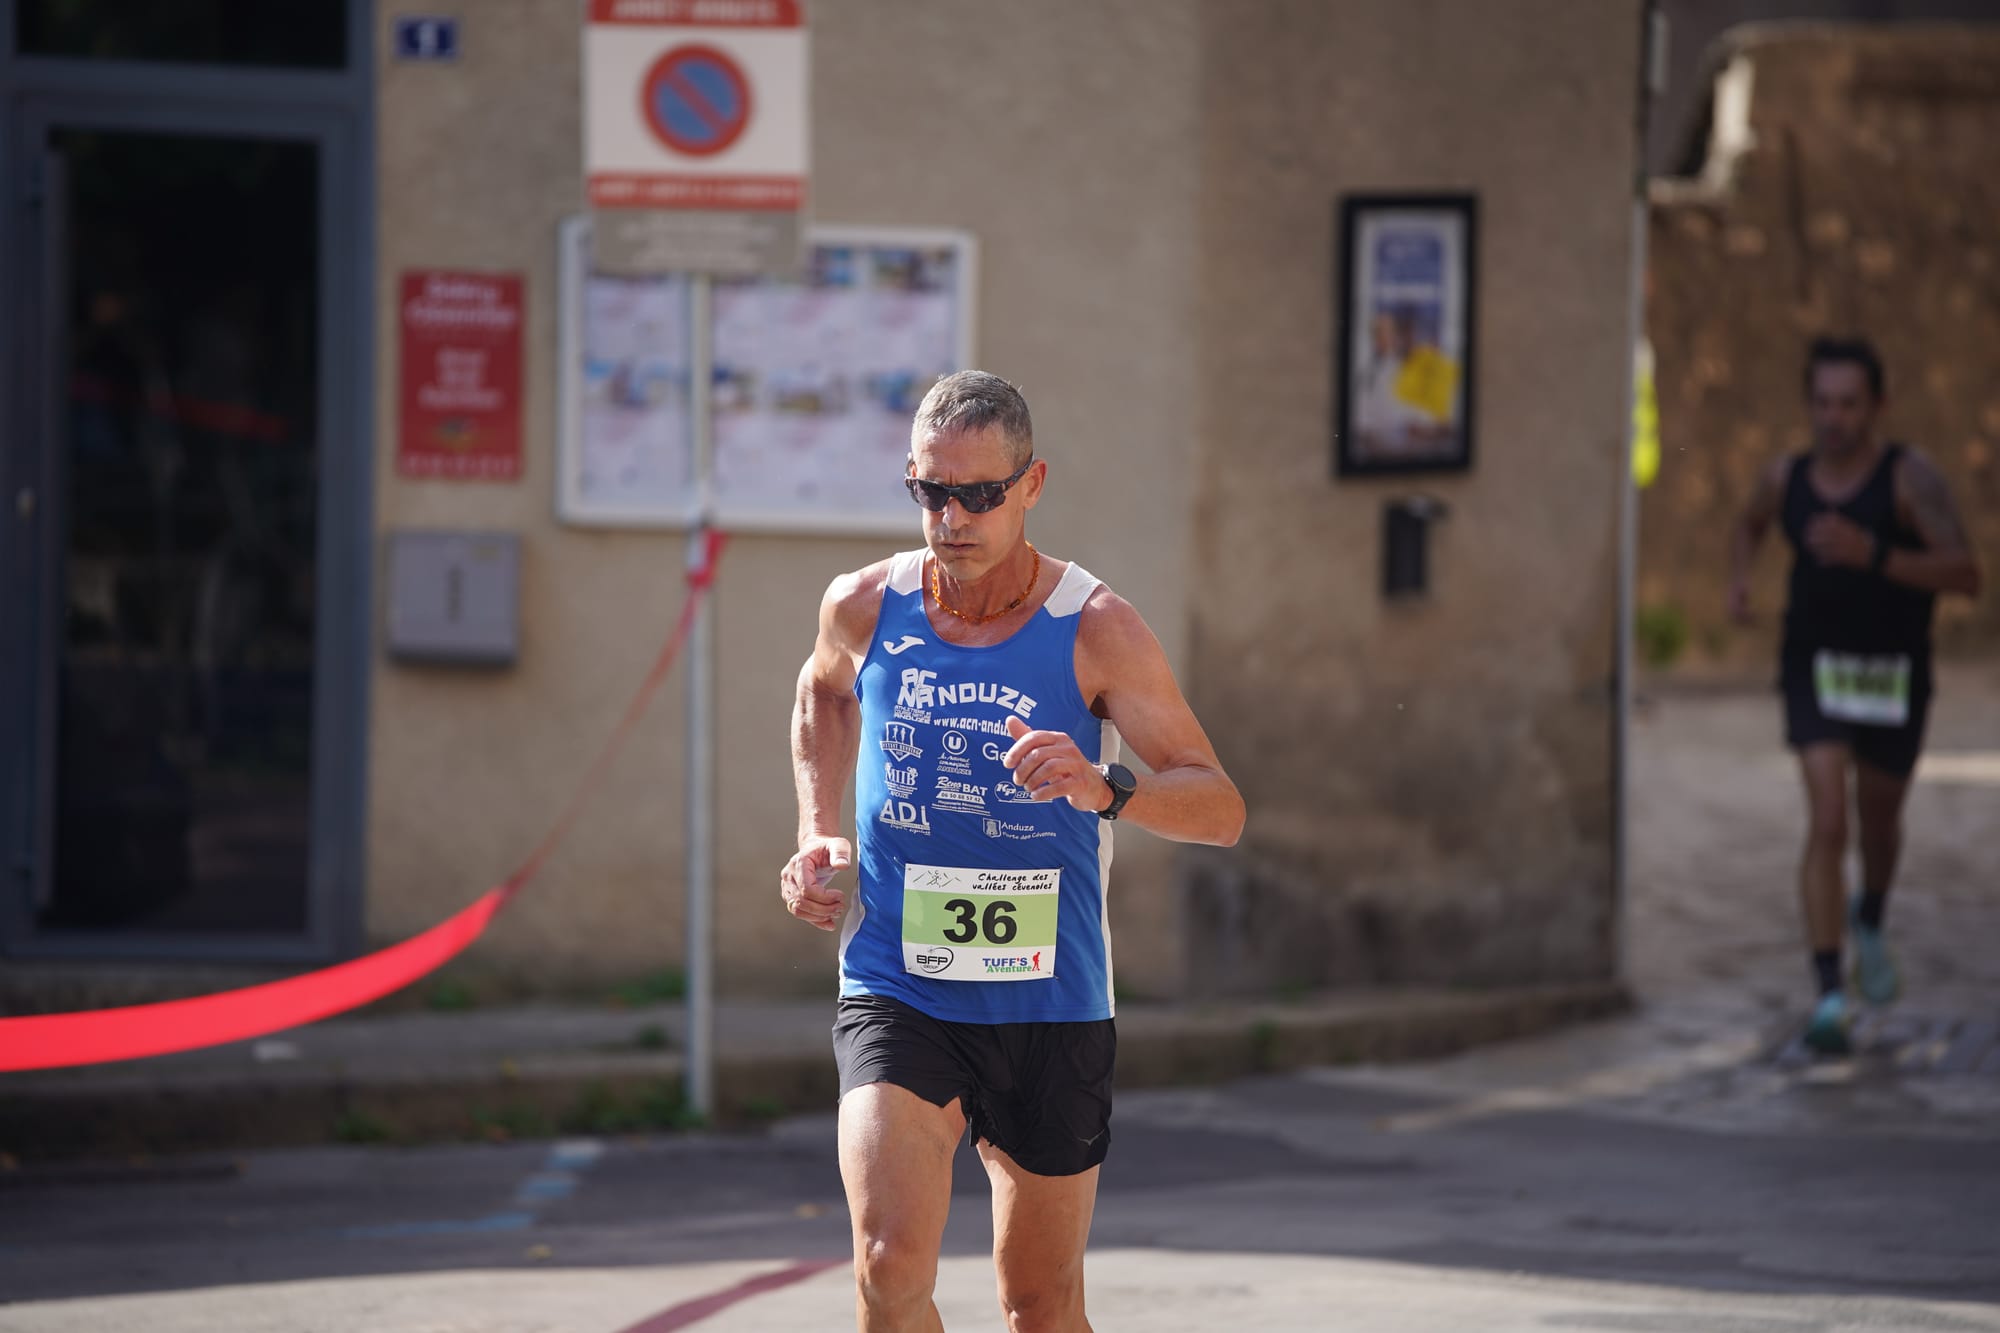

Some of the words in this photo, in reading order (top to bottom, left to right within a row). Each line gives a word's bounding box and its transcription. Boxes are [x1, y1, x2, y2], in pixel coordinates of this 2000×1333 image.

[963, 784, 988, 796] BAT
[1001, 822, 1034, 831] Anduze
[978, 873, 1027, 883] Challenge
[1033, 873, 1048, 881] des
[972, 882, 1006, 891] vallées
[1013, 882, 1053, 891] cévenoles
[943, 899, 1017, 944] 36
[916, 954, 948, 966] BFP
[982, 957, 1028, 967] TUFF'S
[986, 965, 1032, 973] Aventure
